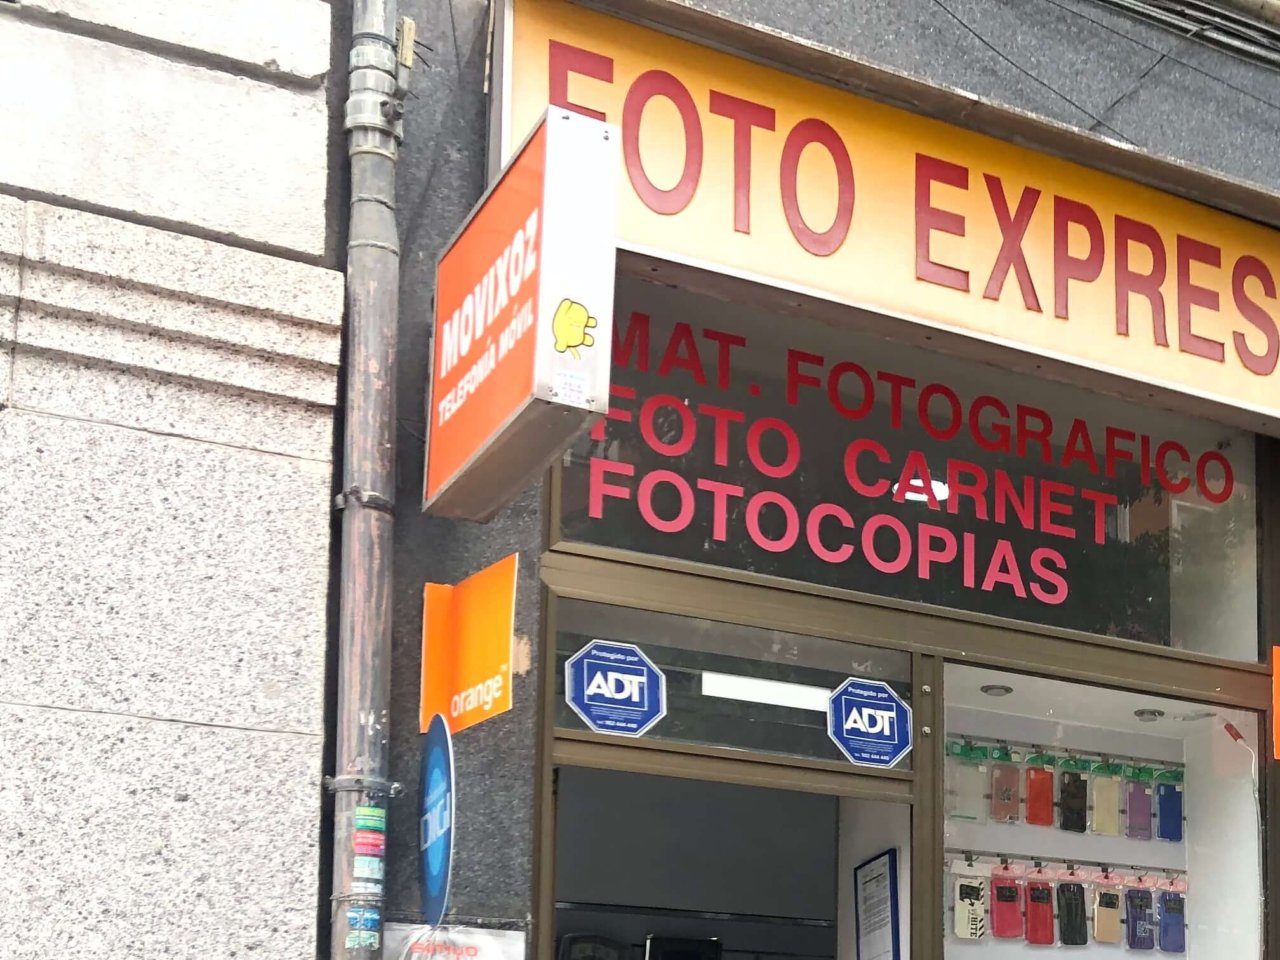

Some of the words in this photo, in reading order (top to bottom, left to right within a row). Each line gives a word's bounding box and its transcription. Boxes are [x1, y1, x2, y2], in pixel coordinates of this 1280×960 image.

[441, 208, 538, 379] MOVIXOZ
[591, 385, 800, 478] FOTO
[844, 439, 1117, 545] CARNET
[612, 312, 760, 395] MAT.
[788, 348, 1233, 504] FOTOGRAFICO
[587, 458, 1070, 604] FOTOCOPIAS
[451, 674, 503, 717] orange
[586, 671, 647, 702] ADT
[845, 707, 895, 736] ADT
